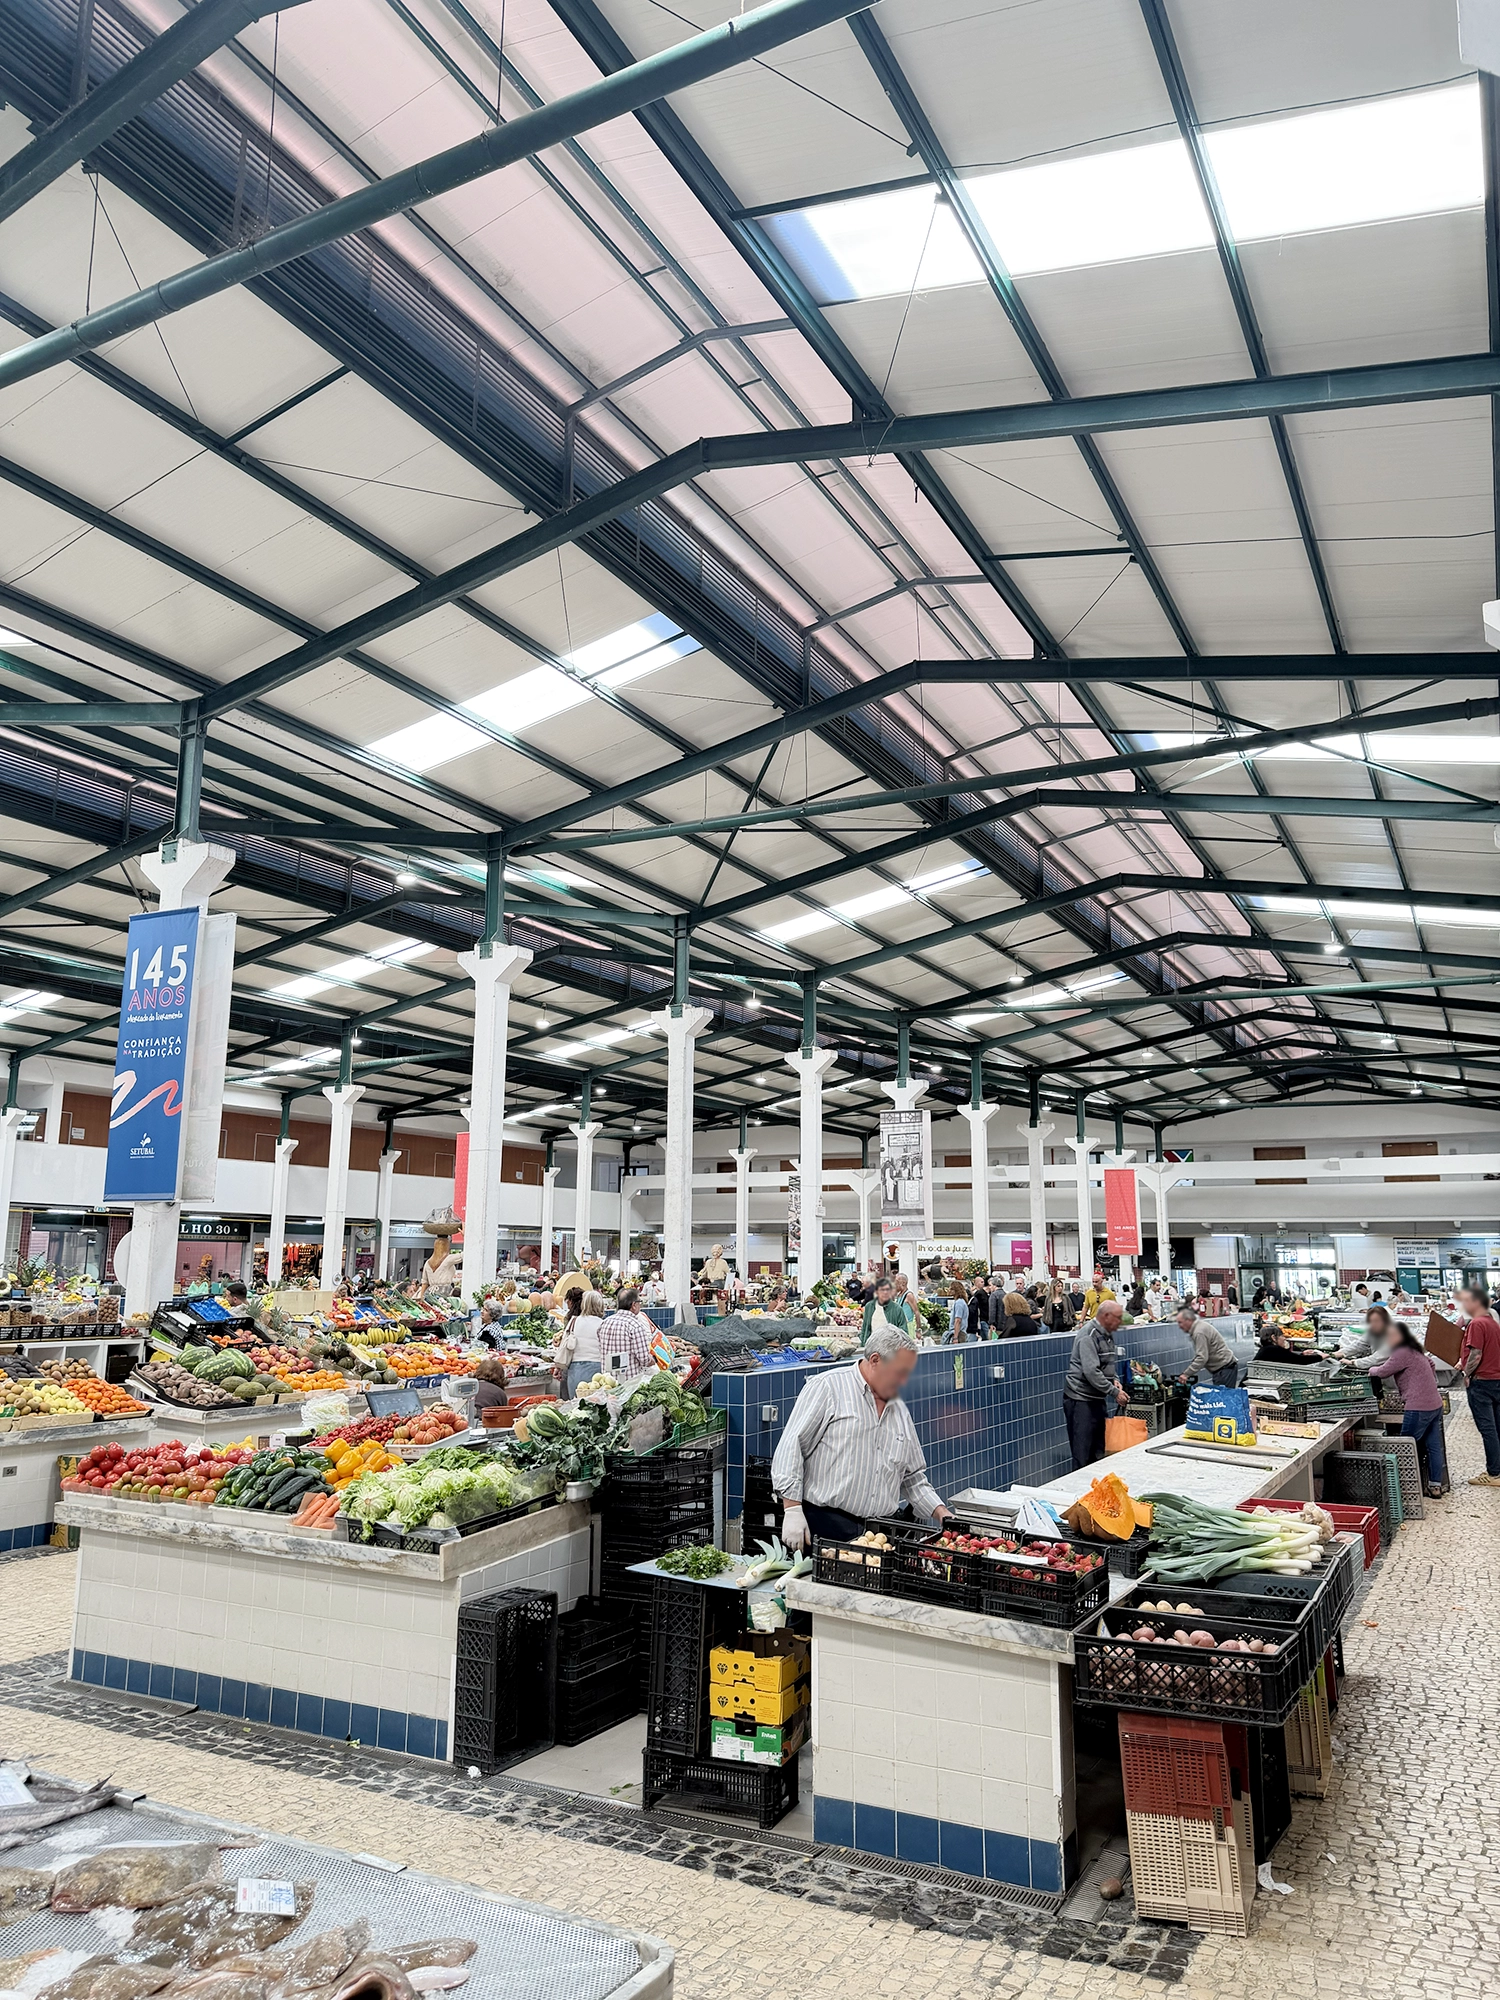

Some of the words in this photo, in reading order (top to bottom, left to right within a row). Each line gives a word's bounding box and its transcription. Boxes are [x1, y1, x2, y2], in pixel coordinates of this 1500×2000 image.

[129, 944, 188, 990] 145
[127, 985, 186, 1012] ANOS
[123, 1035, 182, 1048] CONFIANÇA
[132, 1045, 181, 1059] TRADIÇÃO
[180, 1224, 212, 1234] LHO
[215, 1225, 231, 1235] 30
